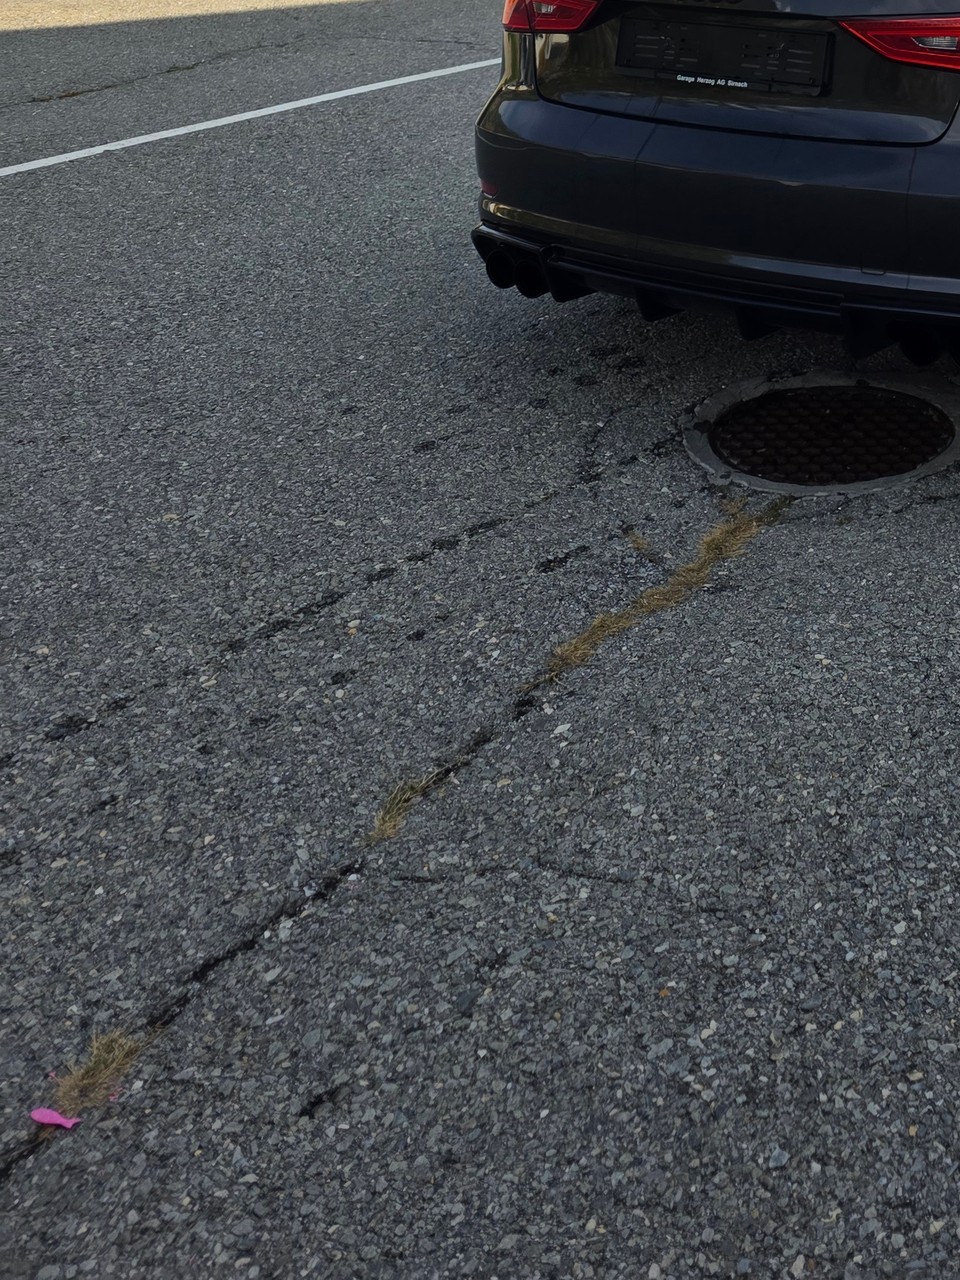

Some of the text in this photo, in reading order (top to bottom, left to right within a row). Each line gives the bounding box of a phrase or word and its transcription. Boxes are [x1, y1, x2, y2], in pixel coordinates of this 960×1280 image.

[676, 74, 695, 83] Garage
[697, 76, 715, 86] Herzog
[727, 80, 748, 88] Sirnach
